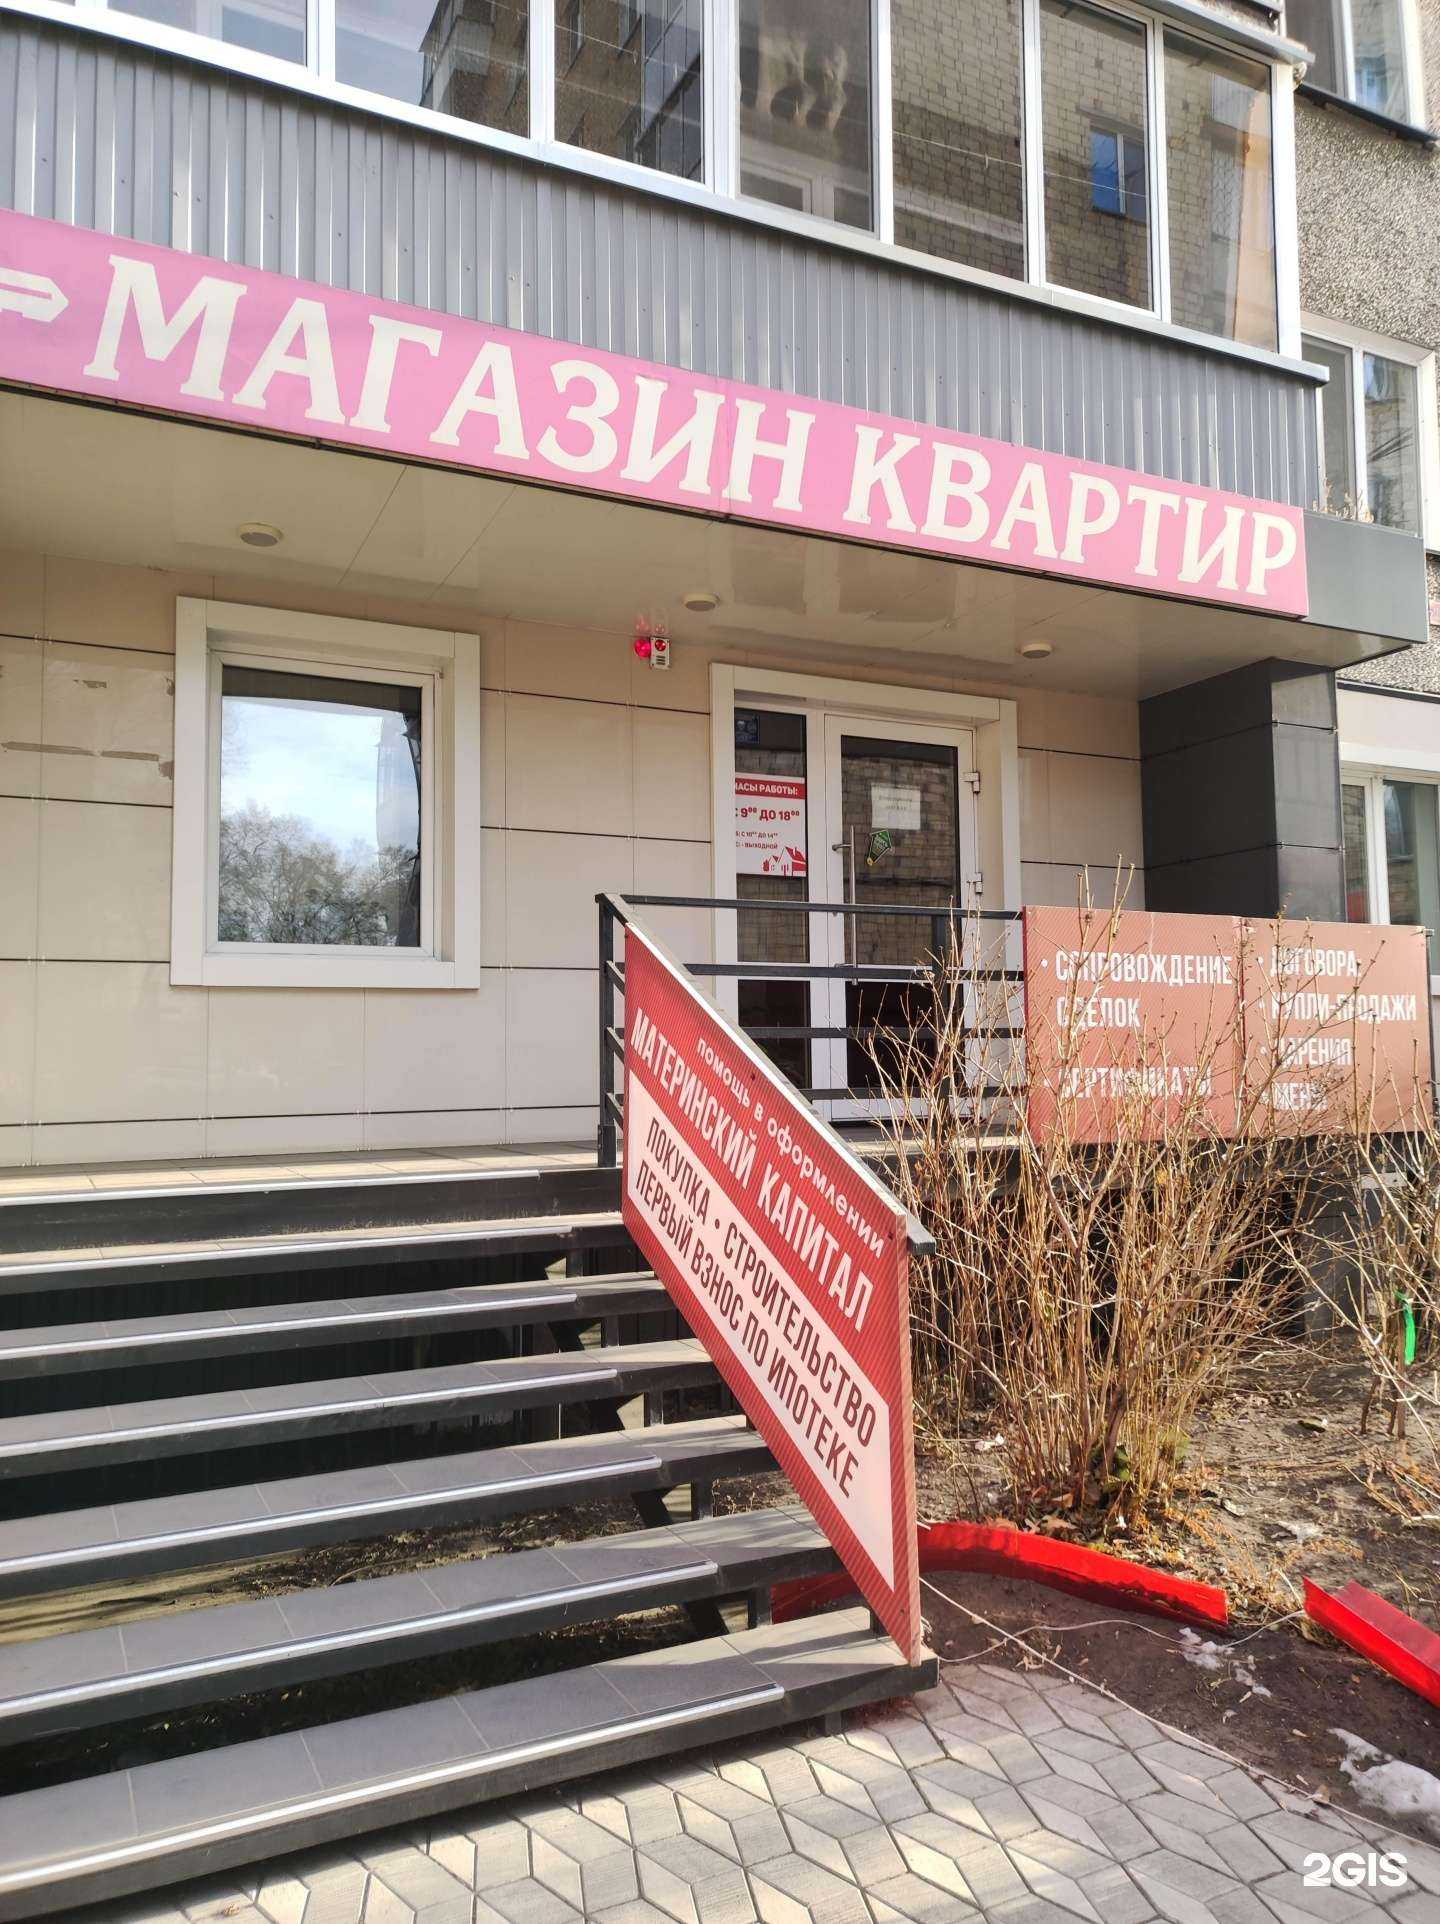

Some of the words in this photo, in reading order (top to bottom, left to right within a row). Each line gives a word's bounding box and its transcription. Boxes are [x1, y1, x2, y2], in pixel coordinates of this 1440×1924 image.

[83, 253, 815, 513] МАГАЗИН
[843, 423, 1297, 596] КВАРТИР
[760, 784, 798, 795] РАБОТЫ:
[760, 809, 776, 821] ДО
[630, 1007, 757, 1190] МАТЕРИНСКИЙ
[756, 1162, 874, 1333] КАПИТАЛ
[646, 1117, 711, 1224] ПОКУПКА
[723, 1221, 877, 1448] СТРОИТЕЛЬСТВО
[697, 1037, 751, 1109] помощь
[754, 1102, 764, 1122] в
[767, 1116, 885, 1259] оформлении
[635, 1159, 694, 1259] ПЕРВЫЙ
[690, 1237, 744, 1332] ВЗНОС
[741, 1310, 770, 1368] ПО
[766, 1346, 860, 1499] ИПОТЕКЕ
